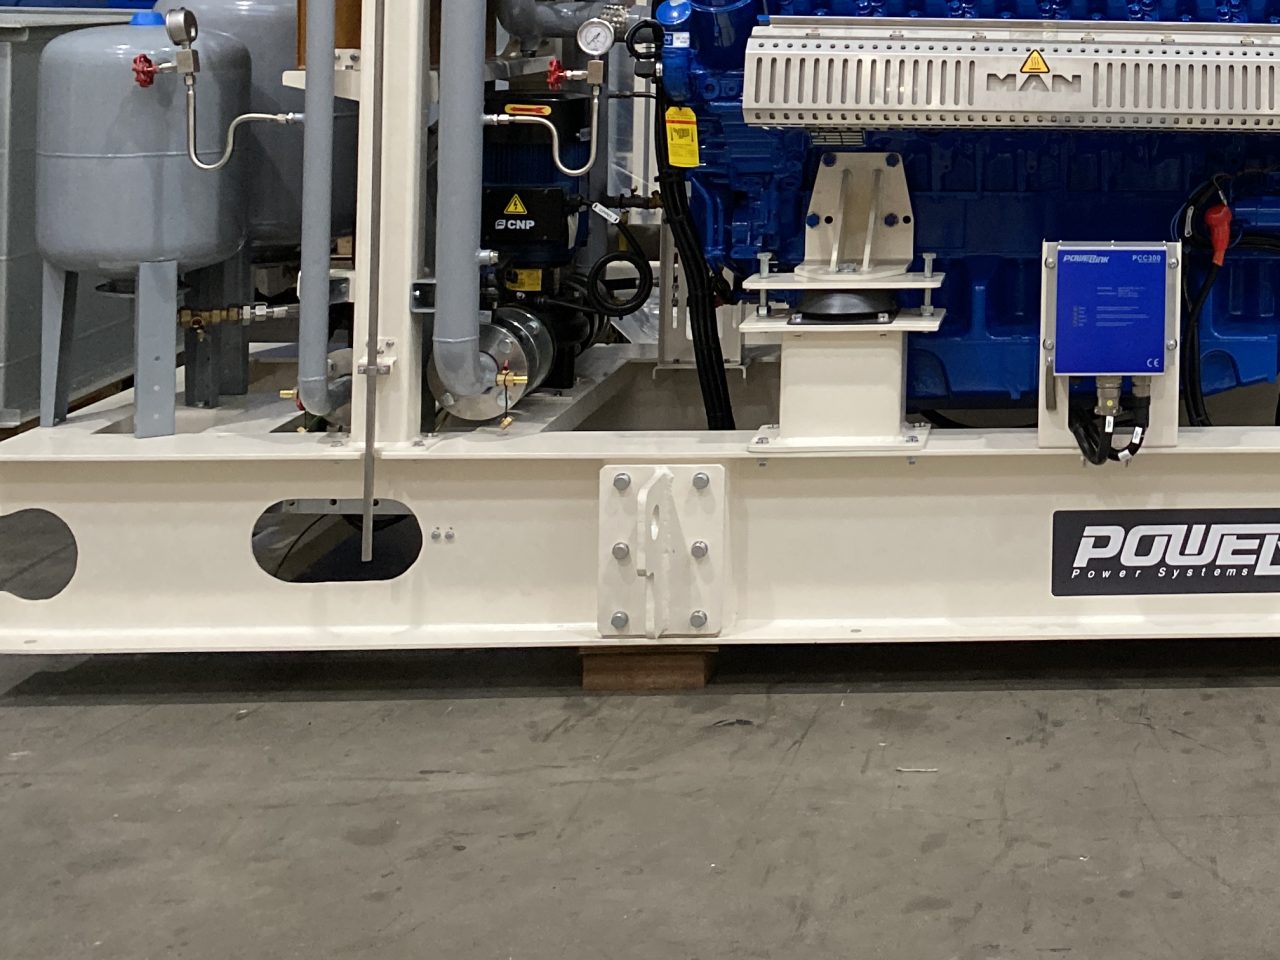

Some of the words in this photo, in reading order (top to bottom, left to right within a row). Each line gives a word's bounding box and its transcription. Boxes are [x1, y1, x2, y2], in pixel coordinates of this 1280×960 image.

[986, 73, 1082, 92] MAN
[507, 219, 535, 230] CNP
[1071, 568, 1142, 579] Power
[1157, 567, 1250, 580] Systems
